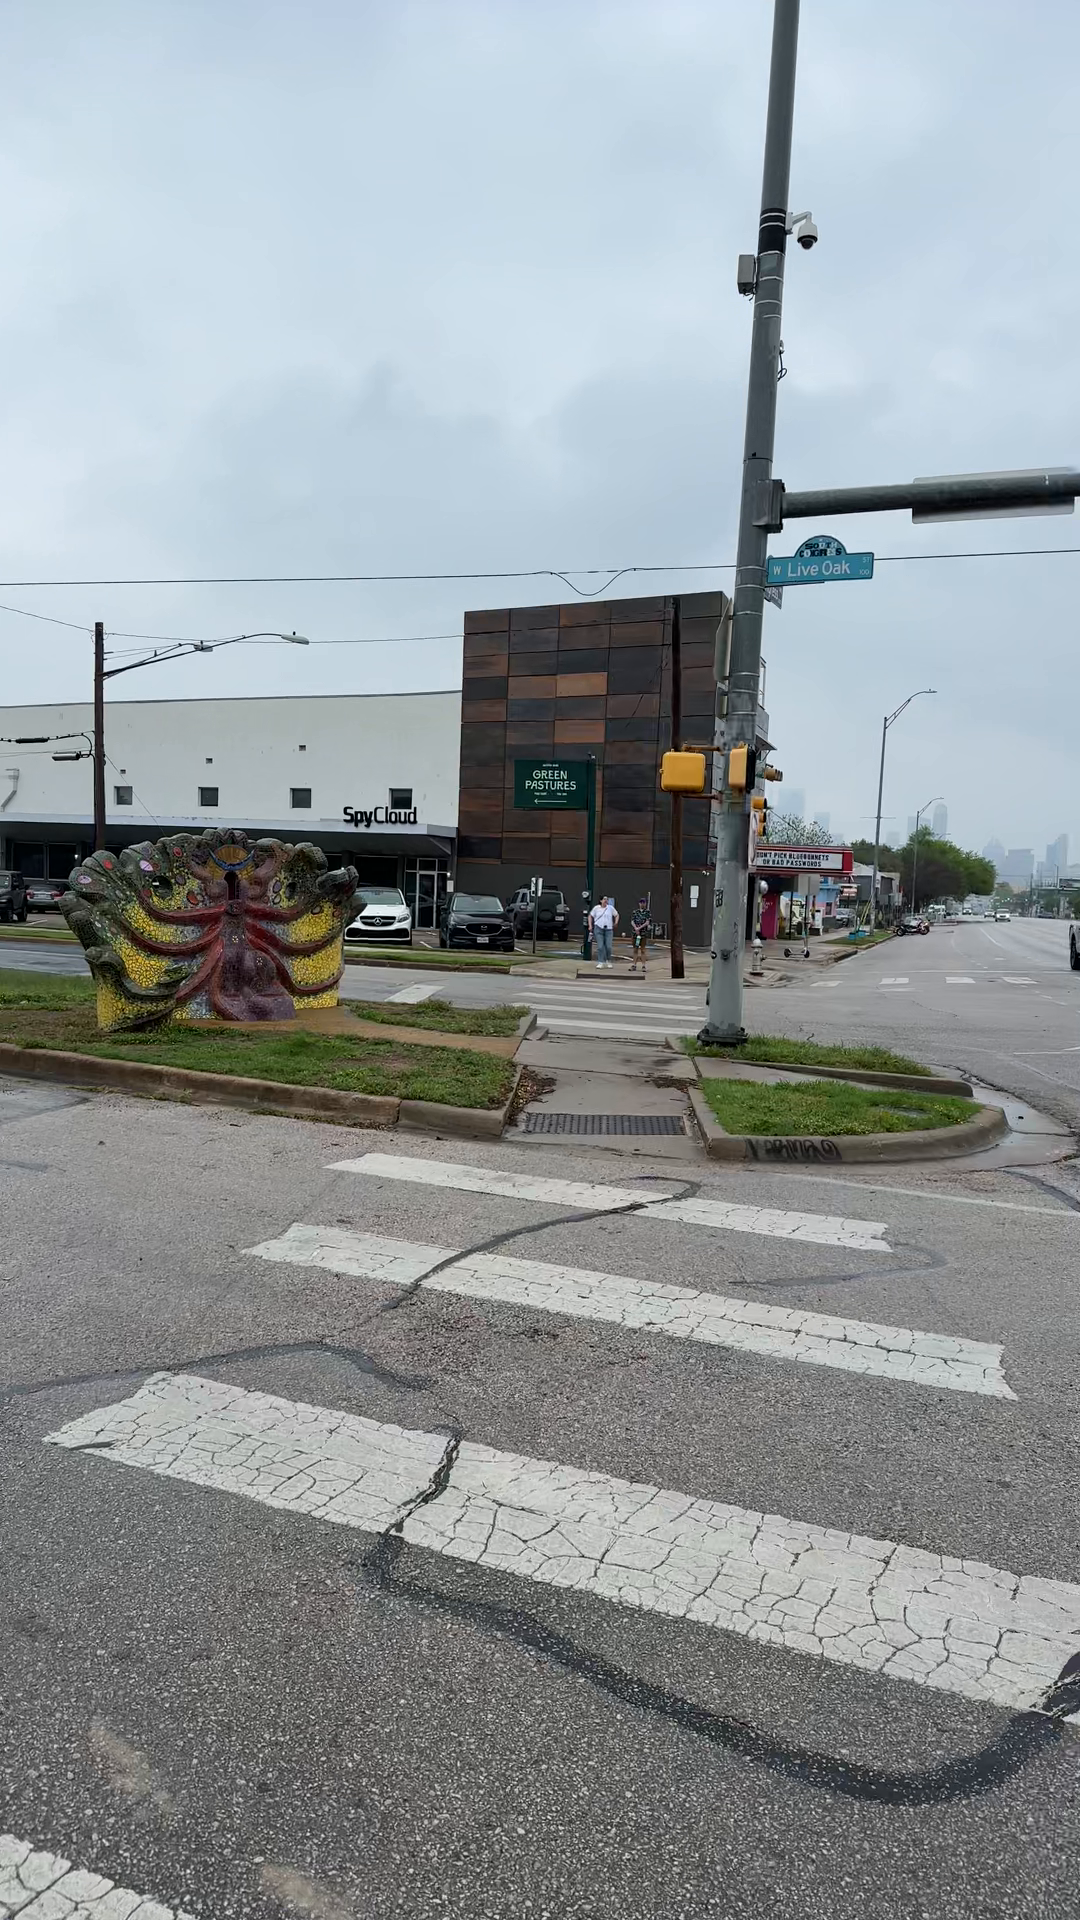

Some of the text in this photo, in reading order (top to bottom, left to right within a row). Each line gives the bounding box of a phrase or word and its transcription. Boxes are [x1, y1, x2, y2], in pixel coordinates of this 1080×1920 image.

[804, 542, 837, 550] SOUTH
[773, 560, 851, 577] W Live Oak
[532, 770, 568, 780] GREEN
[525, 780, 577, 790] PASTURES
[343, 806, 418, 828] SpyCloud
